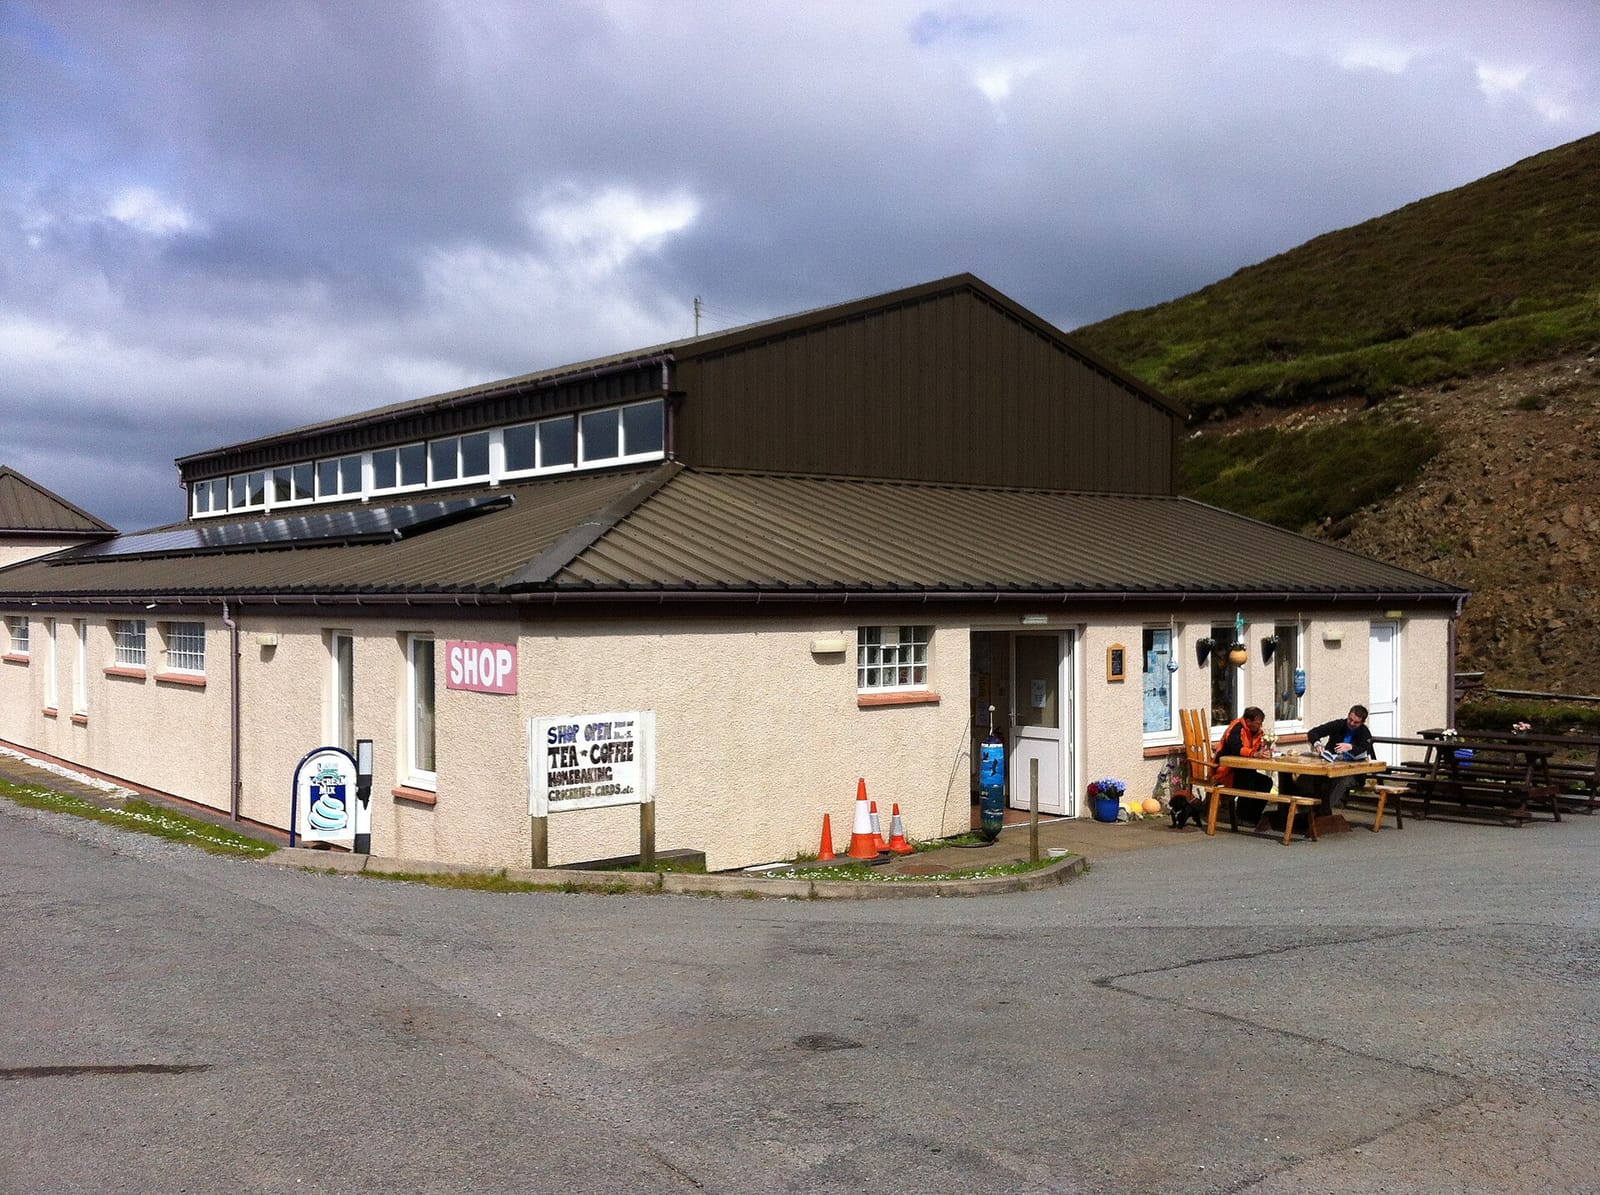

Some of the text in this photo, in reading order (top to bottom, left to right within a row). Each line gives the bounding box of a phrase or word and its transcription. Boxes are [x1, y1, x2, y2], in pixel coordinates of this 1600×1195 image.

[450, 647, 512, 687] SHOP
[547, 724, 580, 744] SHOP
[584, 722, 612, 741] OPEN
[547, 741, 634, 769] TEA COFFEE
[547, 766, 613, 787] HOMEBAKING
[319, 785, 337, 795] MIX
